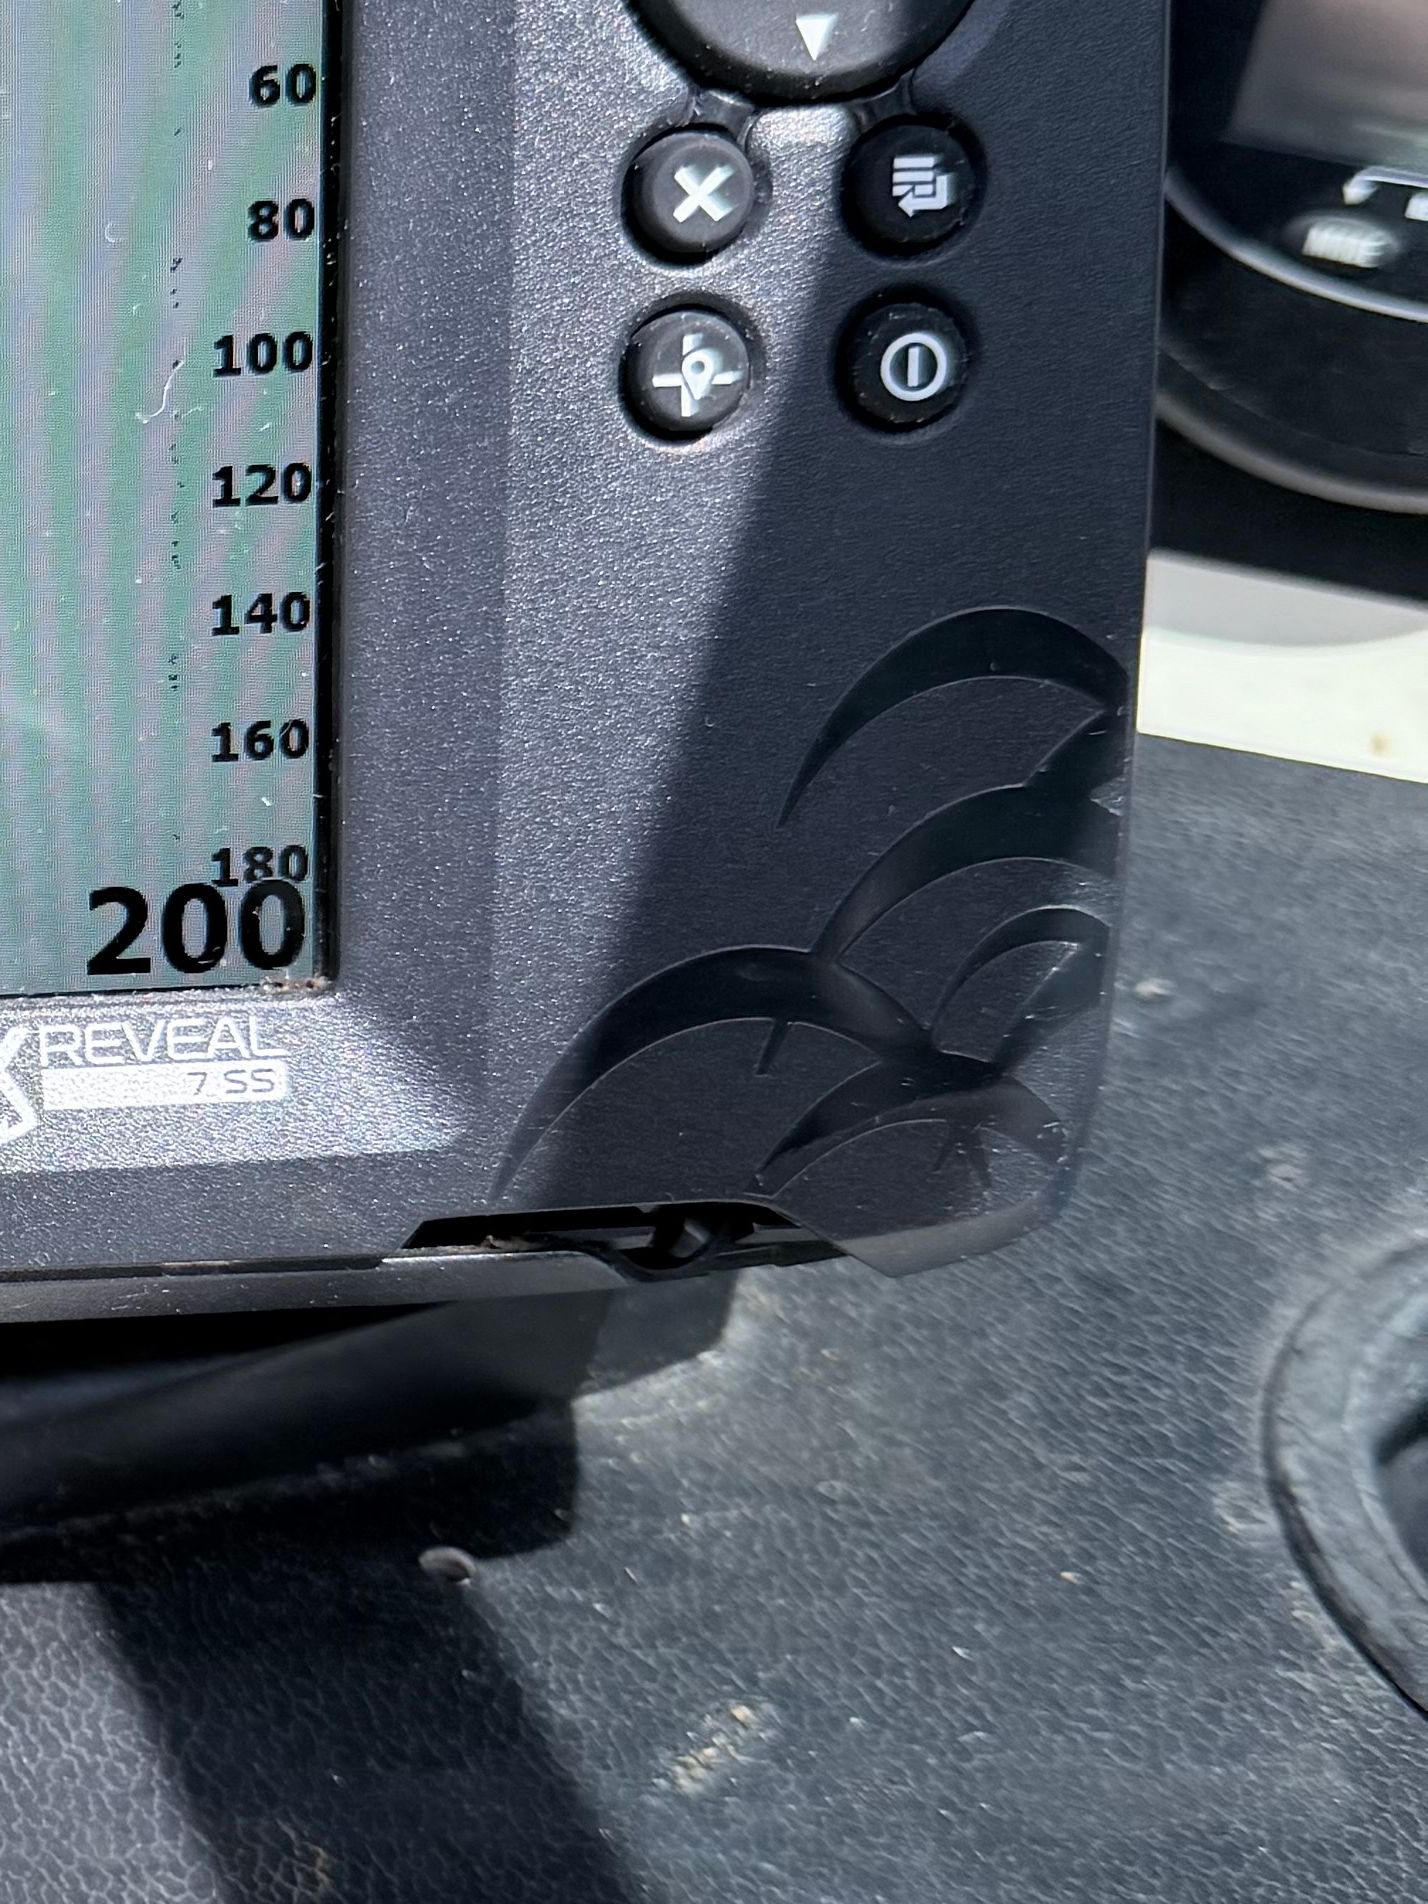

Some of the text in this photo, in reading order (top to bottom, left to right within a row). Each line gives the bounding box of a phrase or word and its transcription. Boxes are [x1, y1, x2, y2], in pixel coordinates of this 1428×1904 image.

[248, 62, 317, 108] 60
[247, 197, 317, 242] 80
[211, 330, 314, 379] 100
[211, 462, 313, 508] 120
[211, 590, 311, 637] 140
[211, 718, 310, 763] 160
[210, 844, 310, 888] 180
[86, 878, 308, 976] 200
[40, 1014, 292, 1068] REVEAL
